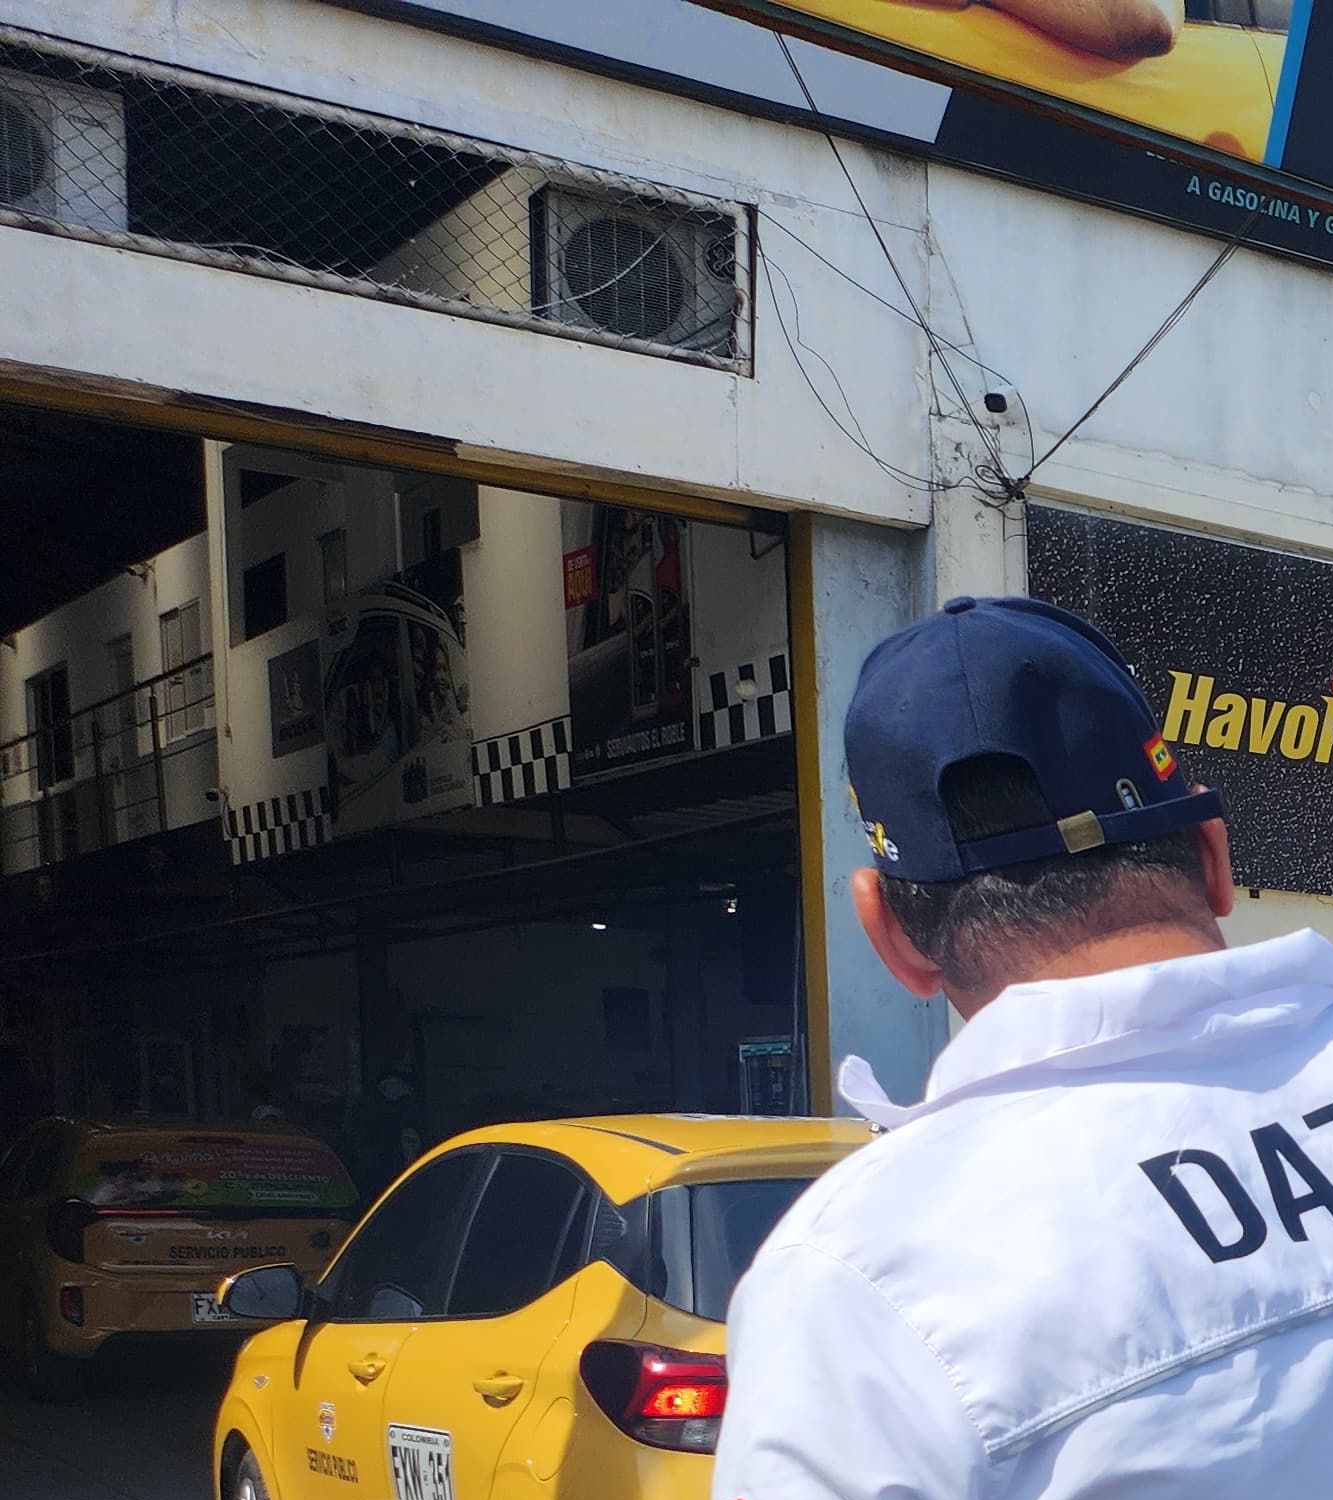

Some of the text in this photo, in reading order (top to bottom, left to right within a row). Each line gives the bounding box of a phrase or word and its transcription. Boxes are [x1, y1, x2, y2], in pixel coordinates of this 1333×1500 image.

[1186, 175, 1201, 196] A
[1307, 208, 1321, 228] Y
[168, 1245, 287, 1260] SERVICIO PUBLICO
[194, 1298, 225, 1317] FX
